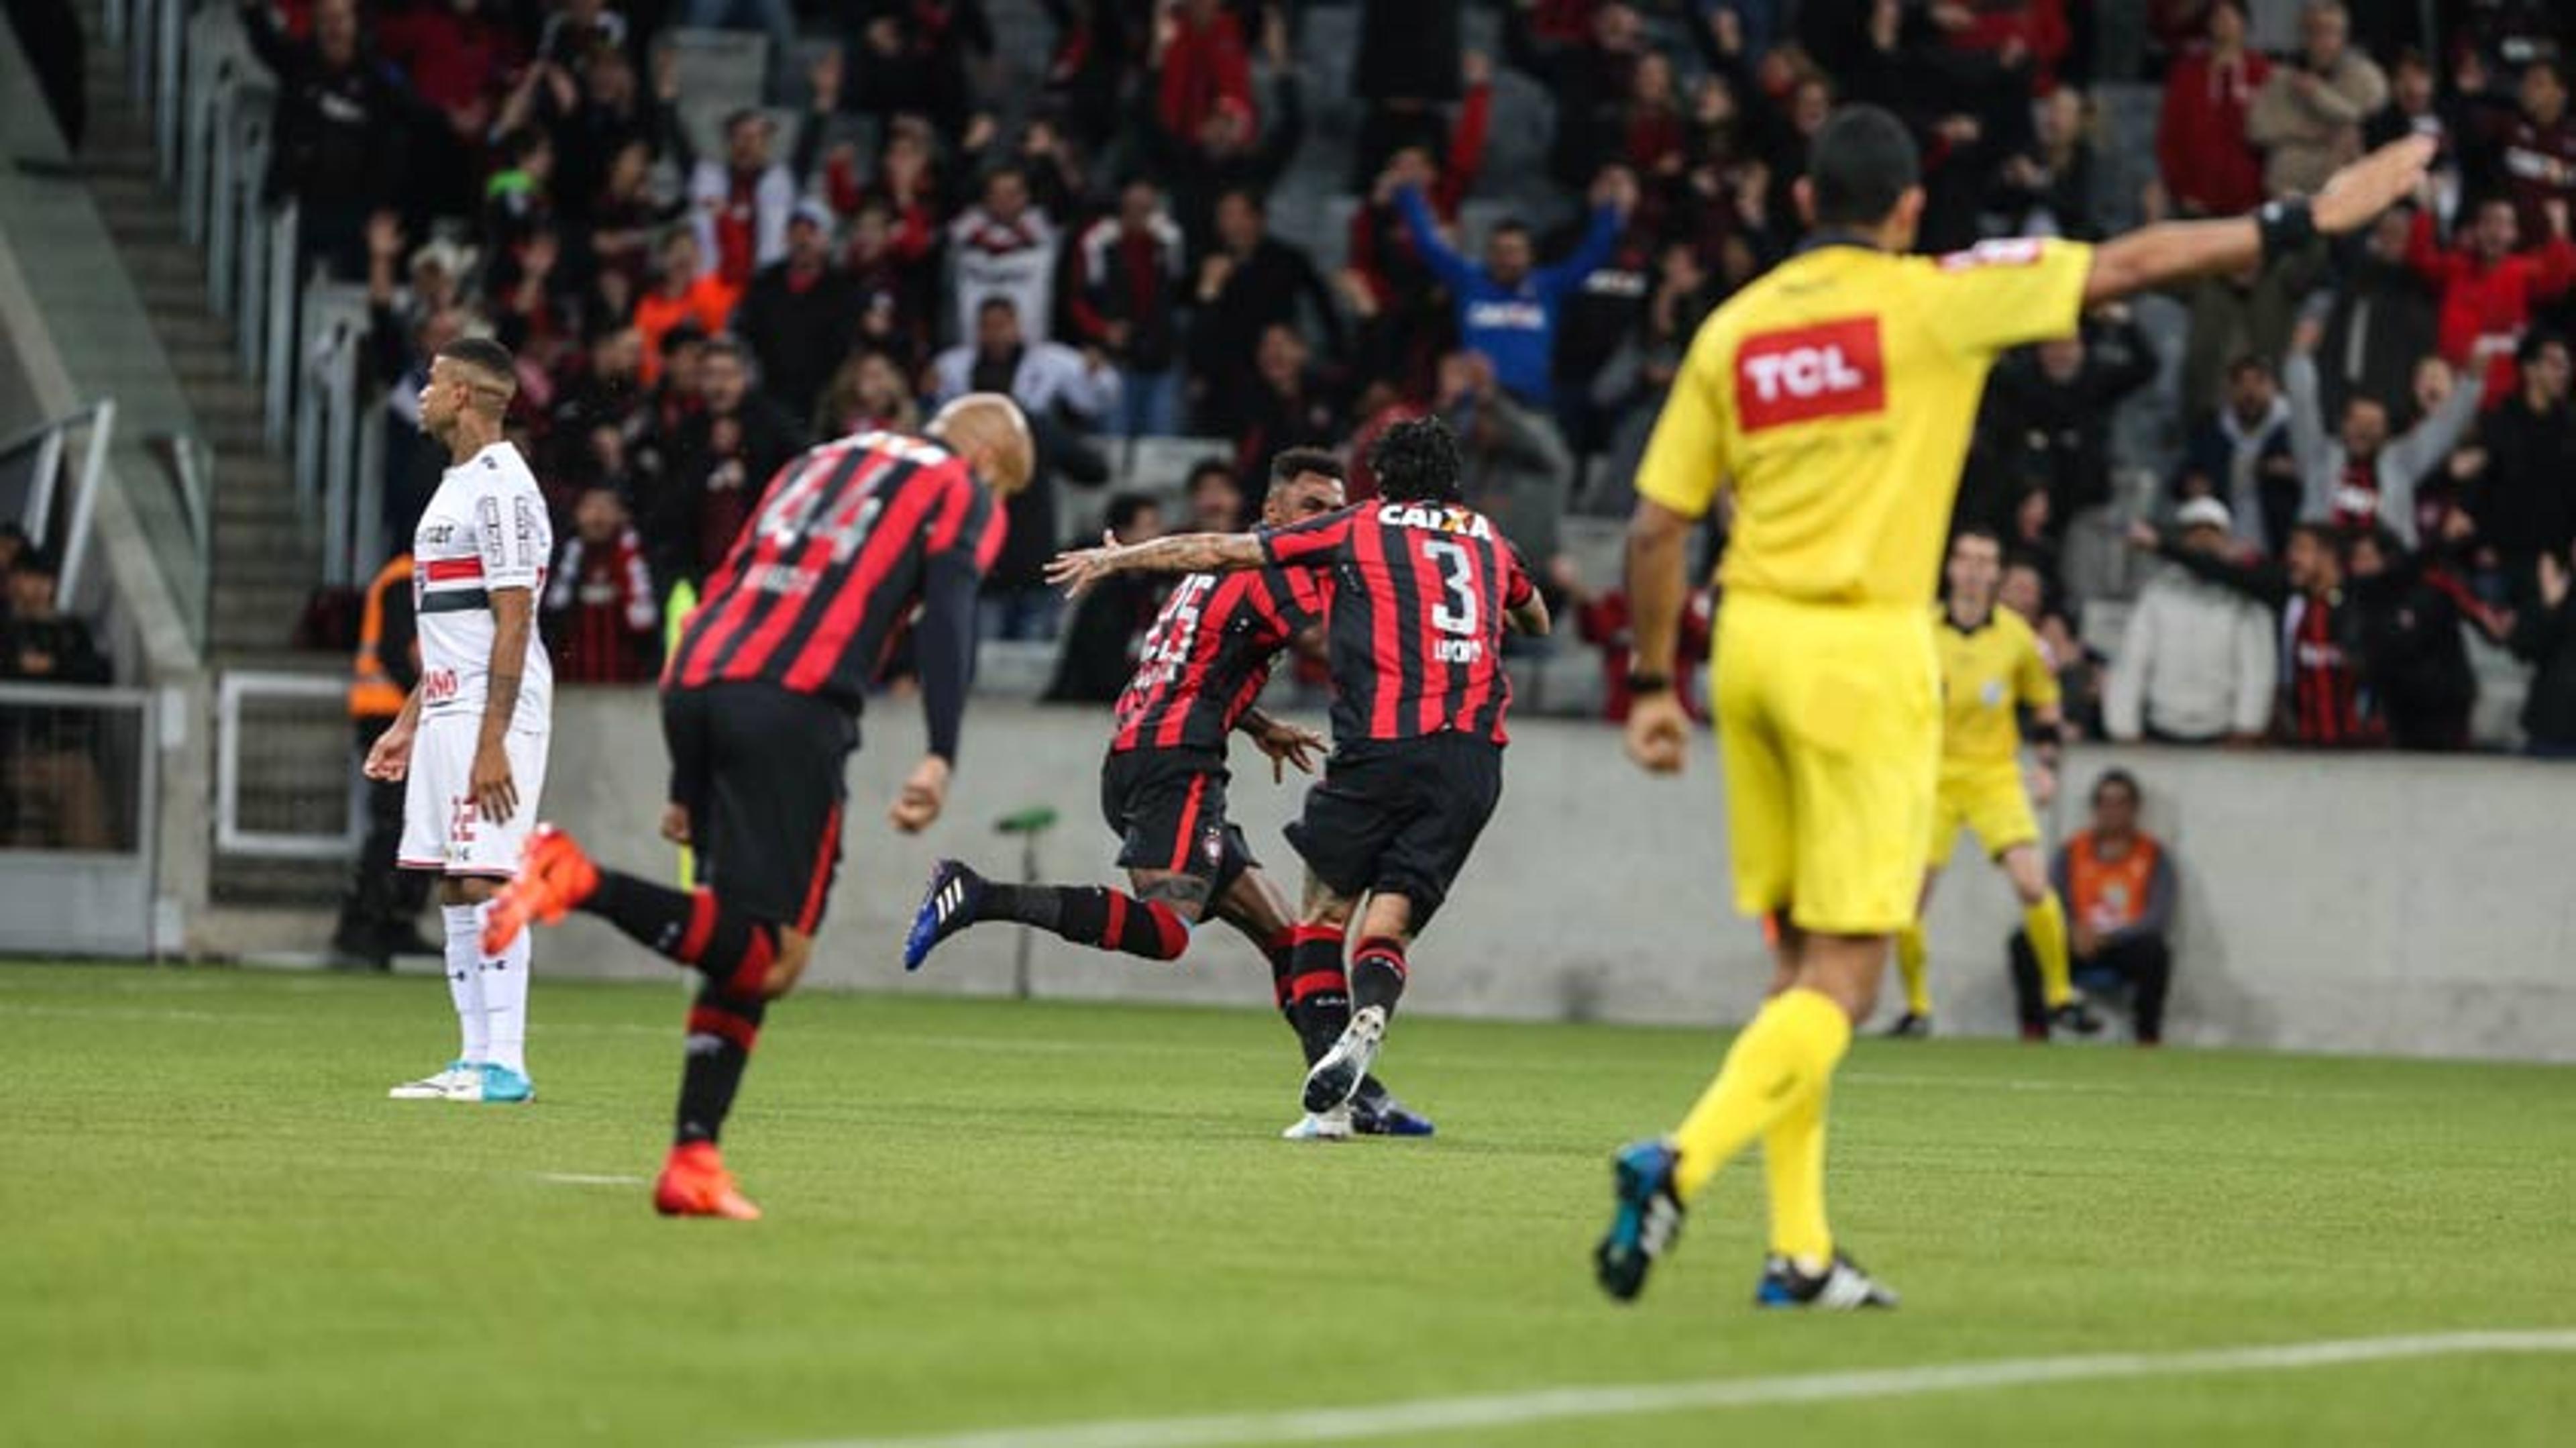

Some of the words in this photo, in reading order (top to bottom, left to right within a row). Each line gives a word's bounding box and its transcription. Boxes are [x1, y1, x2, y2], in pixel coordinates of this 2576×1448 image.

[1743, 344, 1862, 402] TCL
[756, 456, 895, 563] 44
[1378, 505, 1492, 541] CAIXA
[1423, 540, 1477, 635] 3
